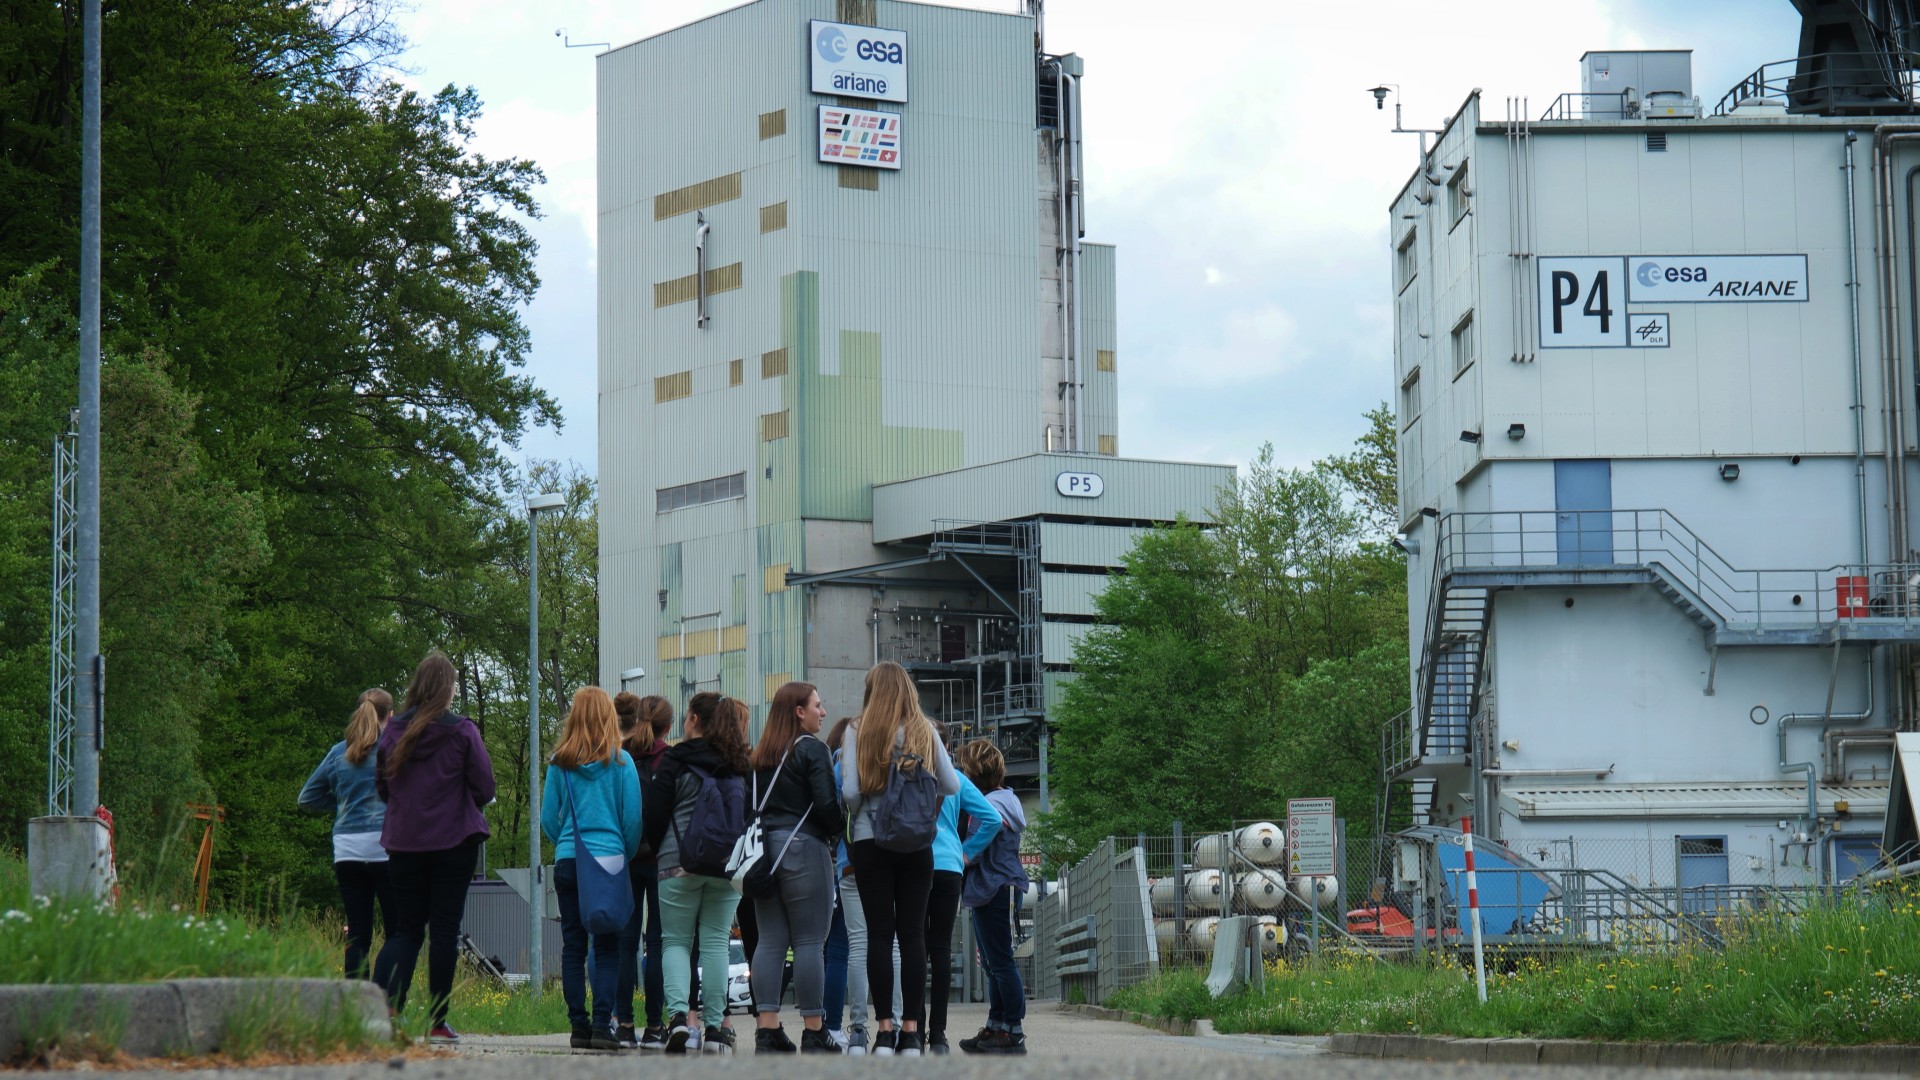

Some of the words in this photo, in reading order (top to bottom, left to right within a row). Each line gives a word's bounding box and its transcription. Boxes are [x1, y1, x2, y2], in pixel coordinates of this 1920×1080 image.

[856, 38, 903, 65] esa
[833, 72, 887, 94] ariane
[1664, 266, 1708, 283] esa
[1707, 280, 1799, 297] ARIANE
[1551, 270, 1613, 334] P4
[1019, 855, 1042, 864] ERST
